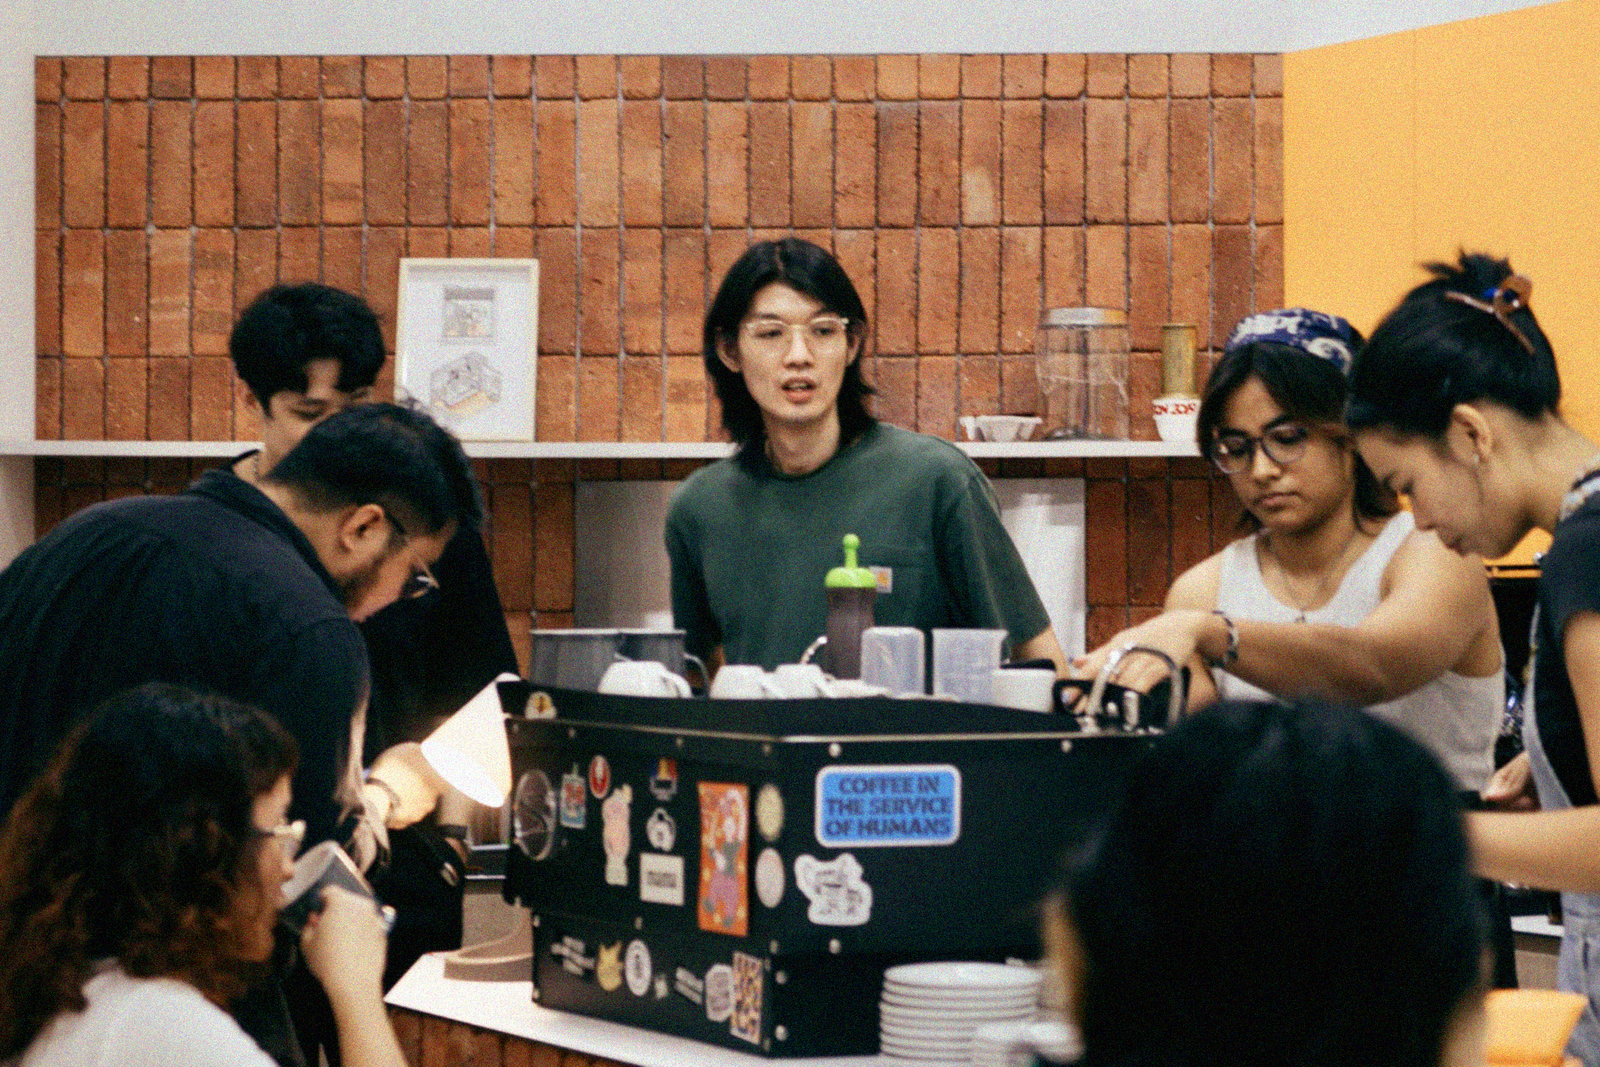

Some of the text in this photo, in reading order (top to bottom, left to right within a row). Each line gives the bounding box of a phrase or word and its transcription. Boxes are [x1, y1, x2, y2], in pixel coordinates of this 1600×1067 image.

[839, 775, 940, 794] COFFEE IN
[826, 797, 950, 816] THE SERVICE
[826, 818, 951, 837] OF HUMANS
